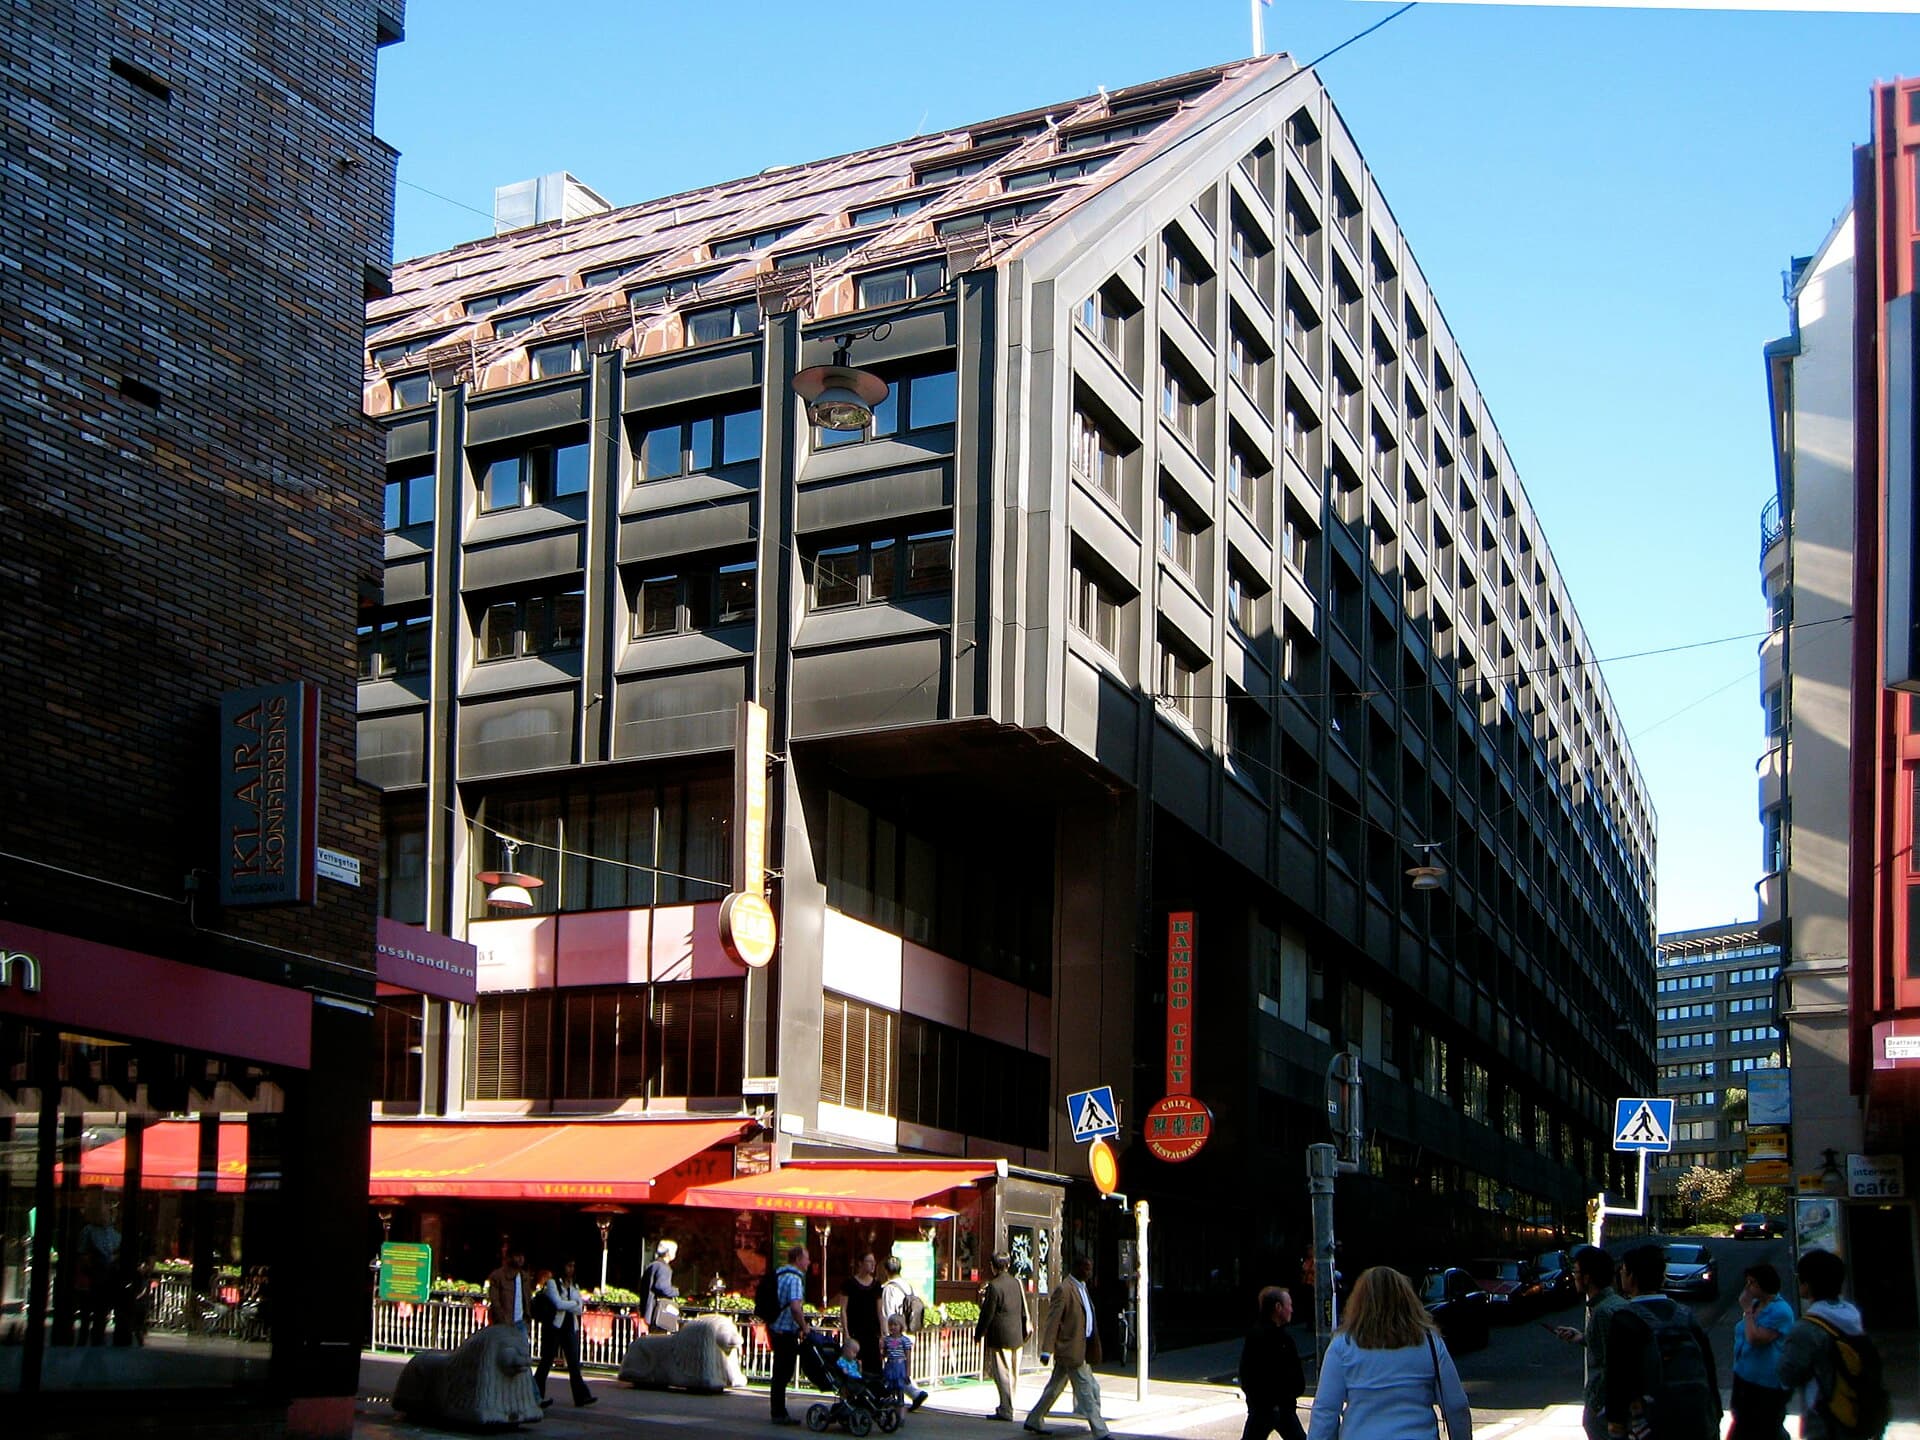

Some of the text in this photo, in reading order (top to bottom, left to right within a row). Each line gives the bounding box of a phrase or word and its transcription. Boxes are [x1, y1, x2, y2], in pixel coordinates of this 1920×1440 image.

[232, 699, 265, 878] KLARA
[266, 696, 288, 876] KONFERENS
[378, 944, 474, 977] osshandlarn
[1170, 920, 1191, 1084] BAMBOO CITY
[1161, 1099, 1192, 1111] CHINA
[1152, 1139, 1202, 1159] RESTAURANG
[1854, 1167, 1897, 1176] internet
